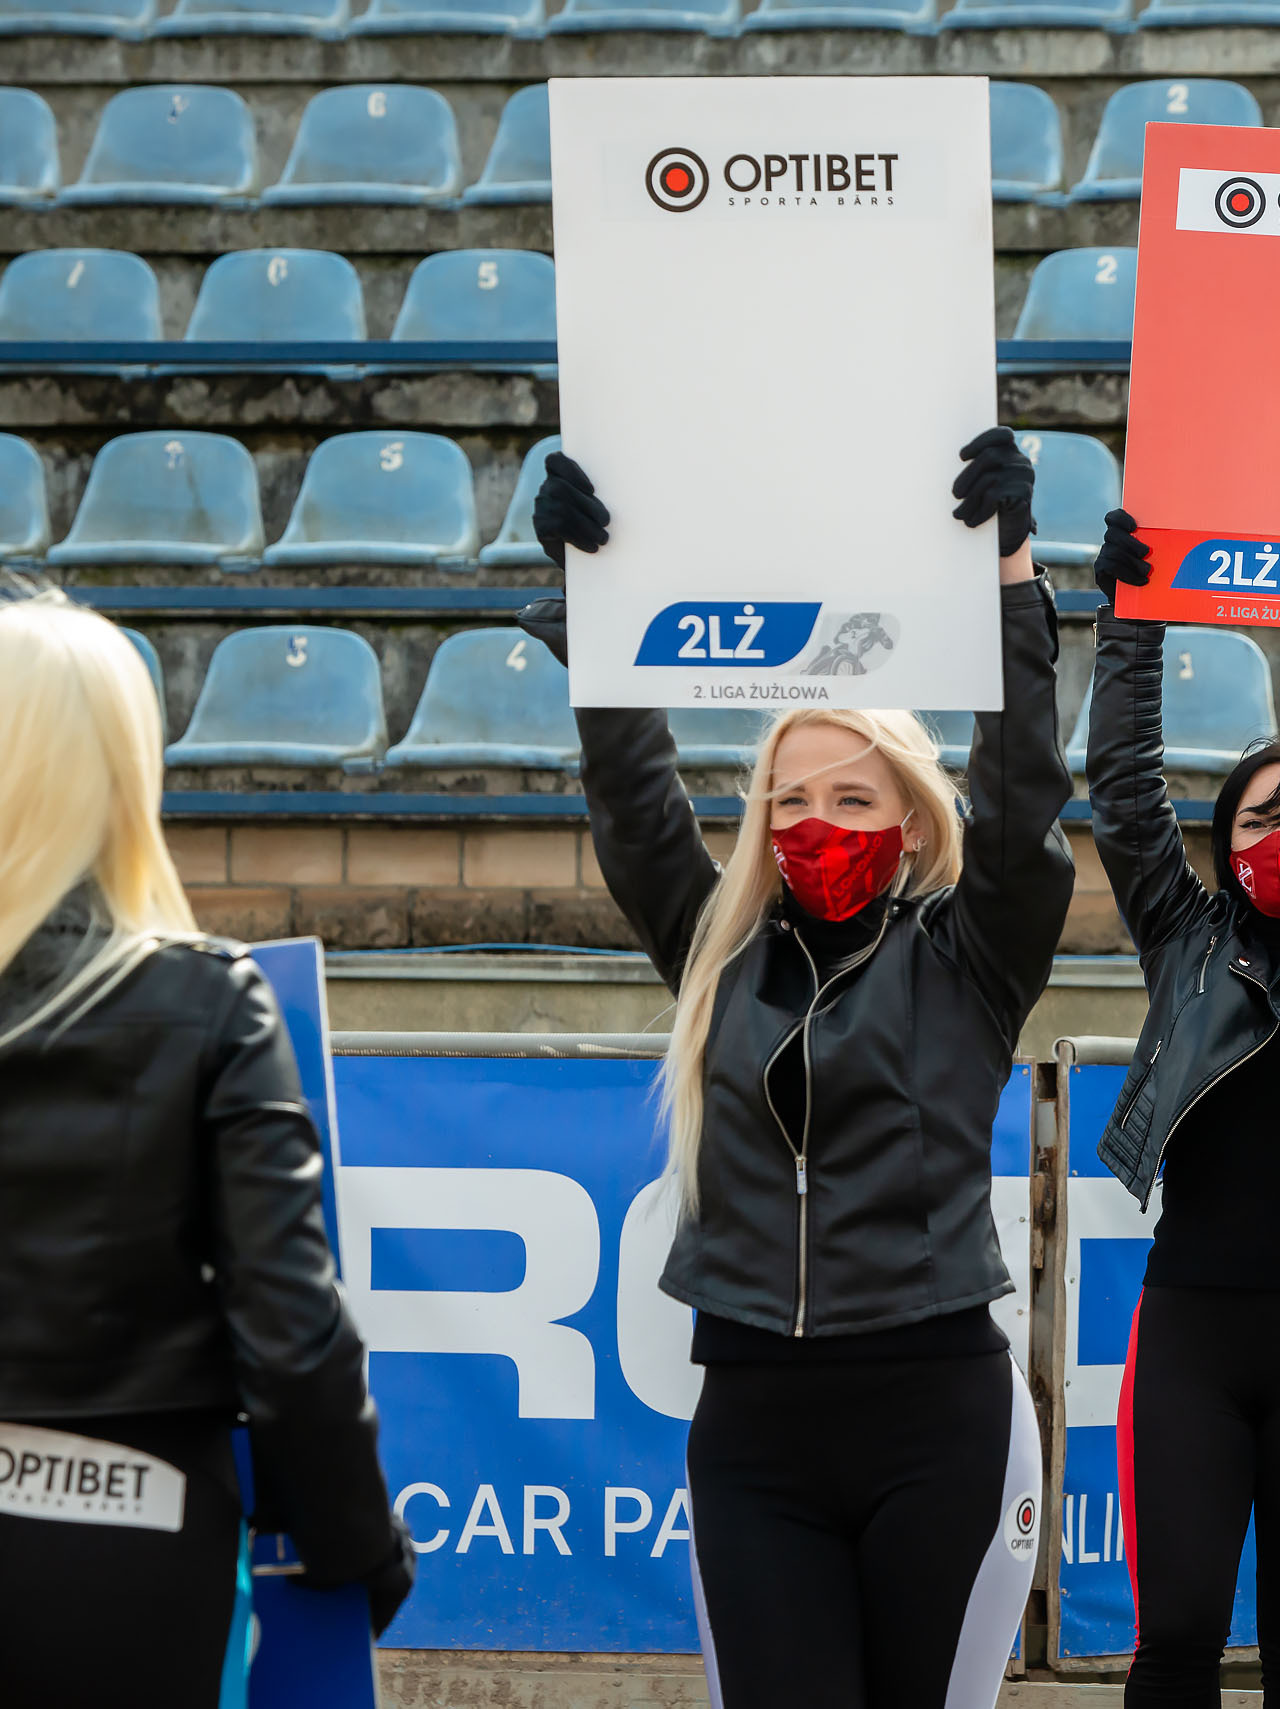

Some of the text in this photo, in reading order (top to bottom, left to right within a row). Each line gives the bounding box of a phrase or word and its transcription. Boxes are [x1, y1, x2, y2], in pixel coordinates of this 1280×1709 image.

[1167, 84, 1189, 114] 2
[724, 154, 899, 192] OPTIBET
[729, 197, 818, 206] SPORTA
[478, 261, 498, 290] 5
[1095, 255, 1118, 284] 2
[1207, 544, 1280, 588] 2LŻ
[1216, 606, 1227, 617] 2.
[1230, 607, 1259, 620] LIGA
[677, 604, 765, 659] 2LŻ
[506, 640, 527, 671] 4
[694, 683, 829, 700] 2. LIGA ŻUŻLOWA
[393, 1482, 573, 1556] CAR
